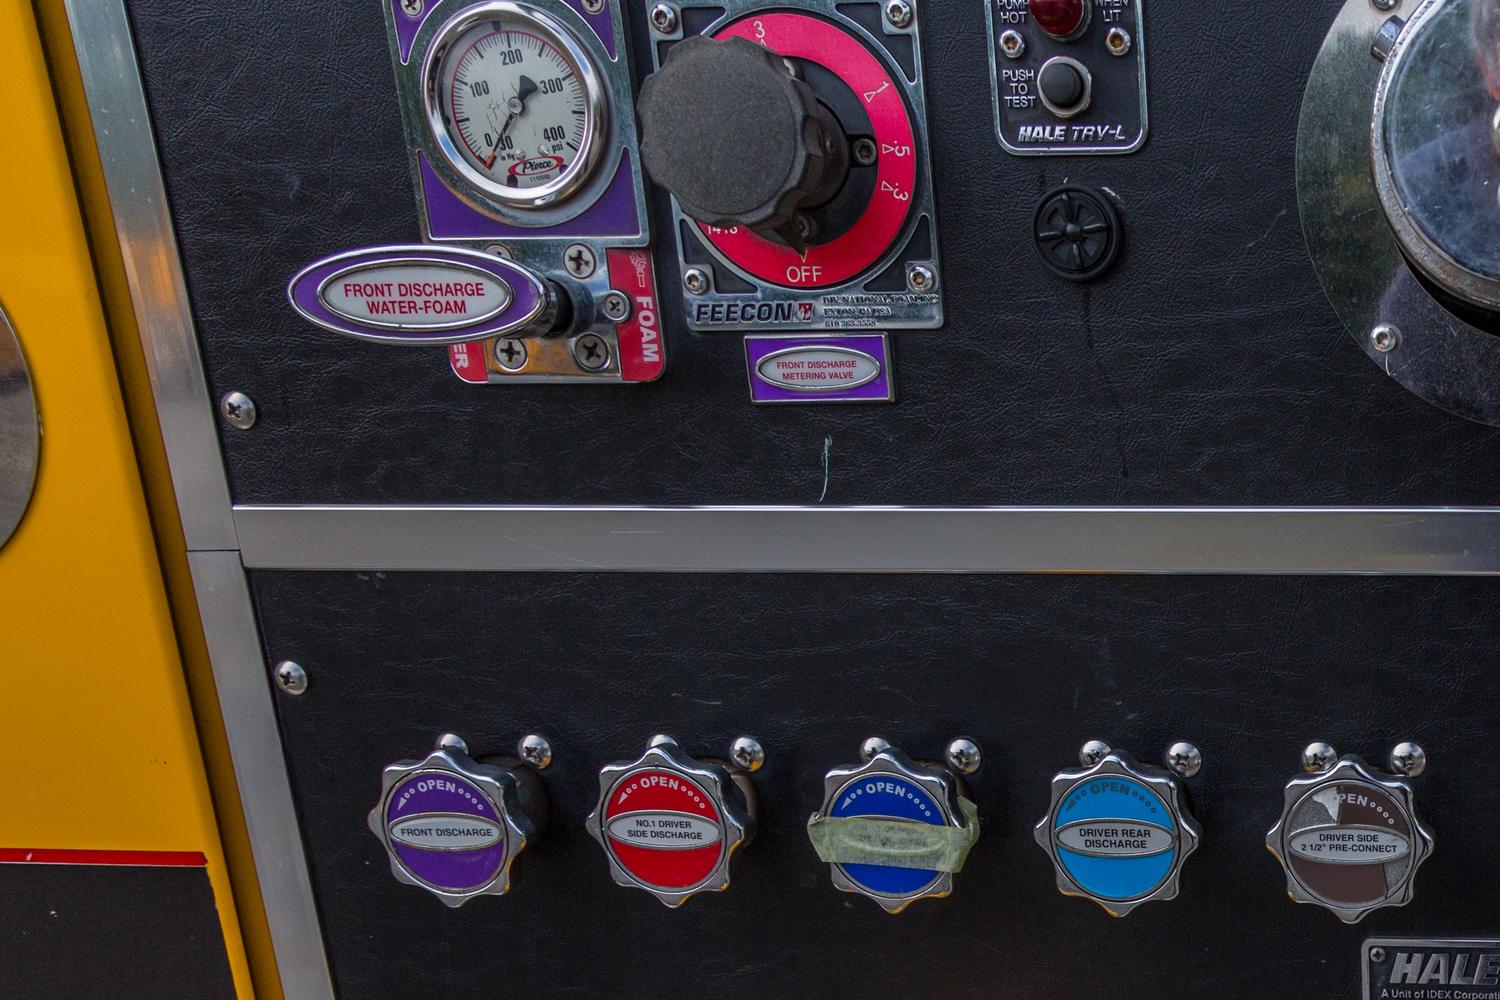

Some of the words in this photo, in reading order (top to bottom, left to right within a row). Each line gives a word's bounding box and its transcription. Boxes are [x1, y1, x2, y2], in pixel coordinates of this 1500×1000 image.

[1001, 12, 1027, 23] HOT
[1103, 10, 1121, 21] LIT
[500, 49, 523, 65] 200
[1003, 70, 1034, 80] PUSH
[470, 81, 489, 97] 100
[540, 78, 563, 94] 300
[1010, 84, 1027, 94] TO
[1004, 96, 1035, 107] TEST
[544, 126, 565, 142] 400
[1018, 126, 1066, 141] HALE
[1072, 125, 1125, 140] TRV-L
[485, 133, 492, 146] 0
[552, 142, 563, 152] psi
[523, 159, 552, 173] Pierce
[786, 266, 822, 282] OFF
[344, 283, 392, 297] FRONT
[398, 283, 485, 297] DISCHARGE
[367, 301, 467, 314] WATER-FOAM
[695, 303, 791, 323] FEECON
[636, 295, 659, 363] FOAM
[782, 372, 825, 380] METERING
[417, 781, 456, 793] OPEN
[640, 776, 678, 790] OPEN
[1090, 781, 1130, 795] OPEN
[866, 783, 905, 797] OPEN
[636, 820, 656, 828] NO.1
[658, 820, 692, 829] DRIVER
[401, 828, 433, 837] FRONT
[435, 828, 493, 837] DISCHARGE
[627, 830, 648, 838] SIDE
[650, 830, 703, 839] DISCHARGE
[1079, 828, 1119, 838] DRIVER
[1121, 829, 1151, 838] REAR
[1320, 834, 1354, 842] DRIVER
[1084, 839, 1147, 849] DISCHARGE
[1329, 845, 1397, 853] PRE-CONNECT
[1382, 989, 1388, 998] A
[1391, 989, 1411, 998] Unit
[1414, 990, 1425, 998] of
[1427, 991, 1450, 999] IDEX
